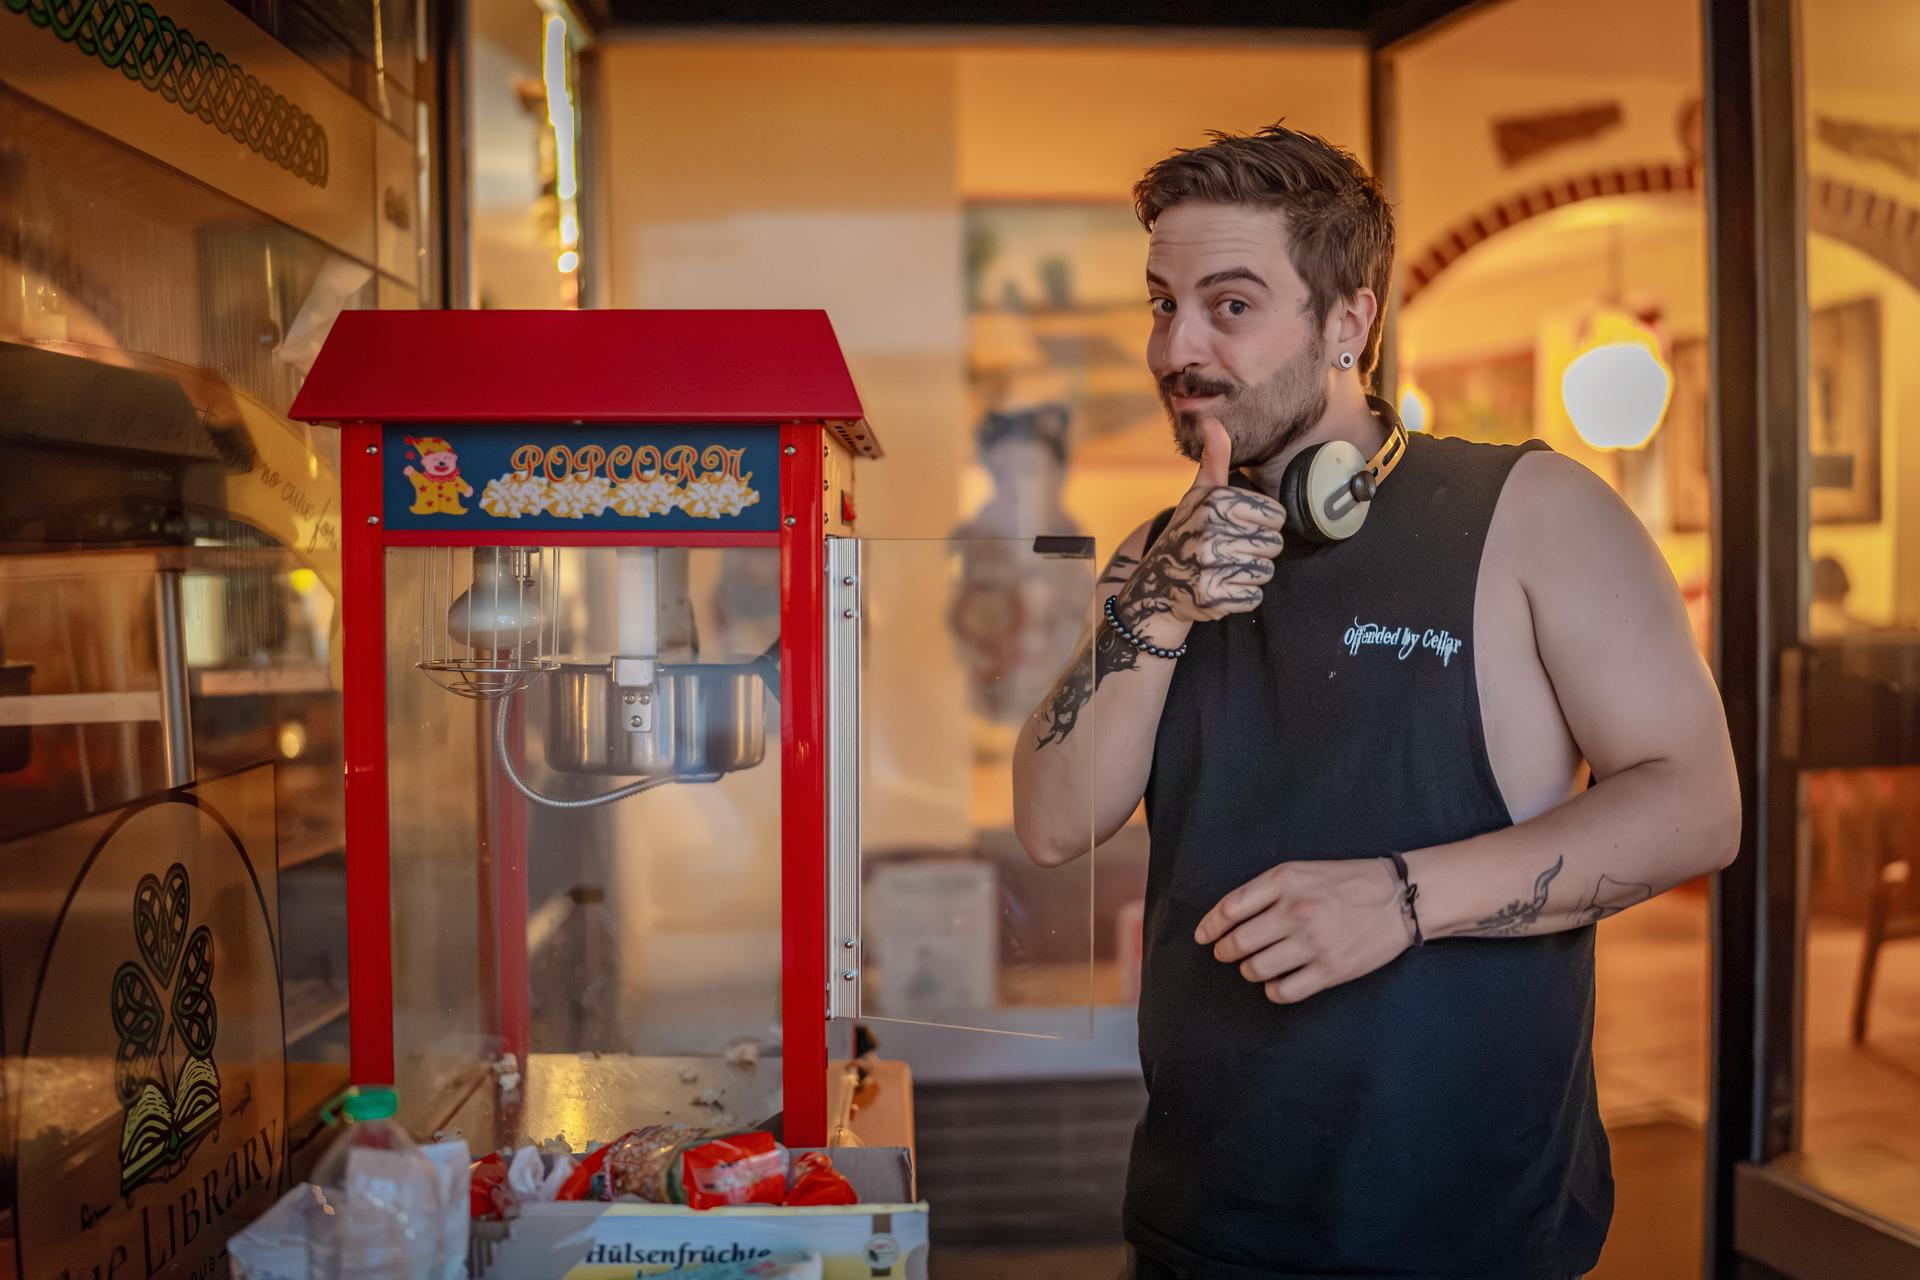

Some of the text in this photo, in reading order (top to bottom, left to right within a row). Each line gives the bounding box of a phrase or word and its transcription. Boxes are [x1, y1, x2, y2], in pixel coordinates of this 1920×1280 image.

[511, 445, 752, 485] POPCORN
[1344, 616, 1461, 667] Offended by Cellar
